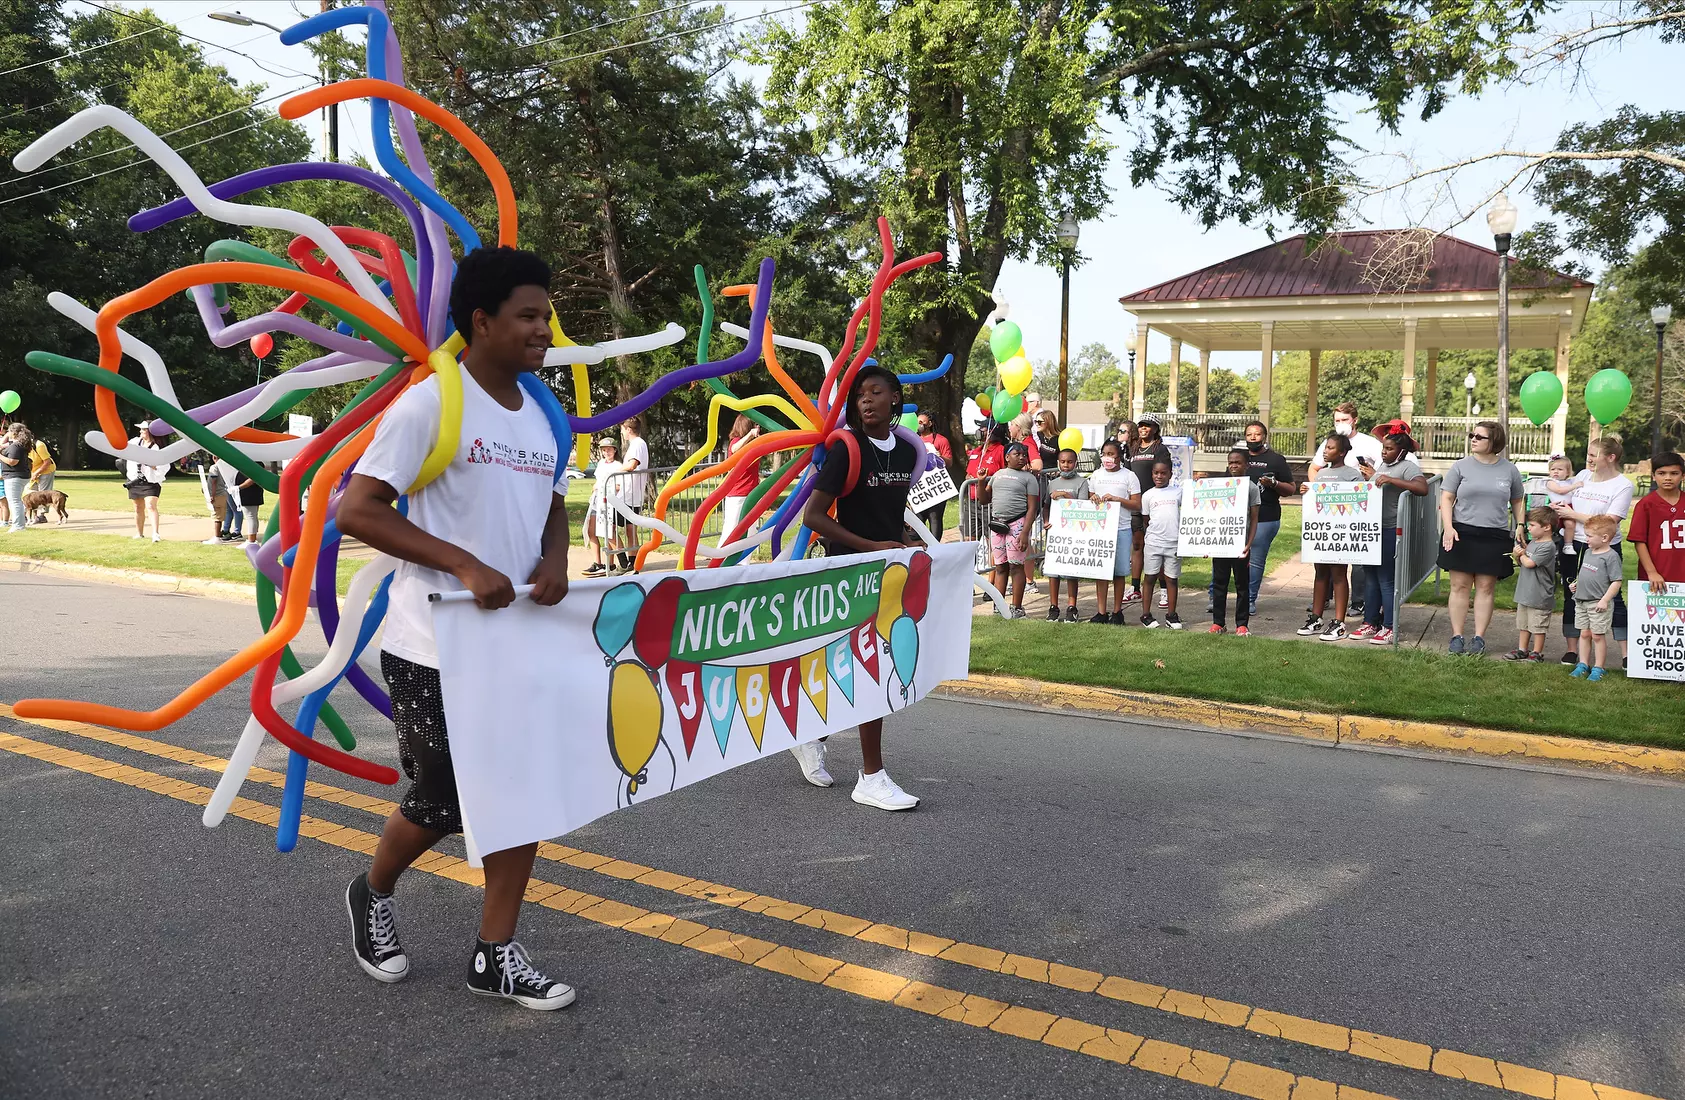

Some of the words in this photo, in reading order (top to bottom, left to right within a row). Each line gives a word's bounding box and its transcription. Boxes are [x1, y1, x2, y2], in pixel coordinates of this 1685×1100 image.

[532, 451, 555, 464] KIDS
[925, 469, 948, 486] RISE
[911, 481, 952, 505] CENTER
[1341, 494, 1358, 502] KIDS
[1182, 516, 1205, 526] BOYS
[1219, 516, 1244, 526] GIRLS
[1304, 521, 1332, 531] BOYS
[1349, 522, 1380, 532] GIRLS
[1180, 527, 1202, 536] CLUB
[1204, 527, 1216, 535] OF
[1219, 526, 1245, 536] WEST
[1049, 535, 1073, 545] BOYS
[1088, 539, 1114, 549] GIRLS
[1188, 537, 1235, 546] ALABAMA
[1302, 532, 1329, 541] CLUB
[1331, 532, 1347, 542] OF
[1349, 532, 1381, 543] WEST
[1046, 545, 1069, 555] CLUB
[1072, 548, 1085, 556] OF
[1088, 548, 1115, 559] WEST
[1313, 542, 1369, 553] ALABAMA
[1055, 555, 1104, 568] ALABAMA
[1648, 597, 1679, 606] NICK'S
[678, 593, 785, 655] NICK'S
[793, 579, 850, 631] KIDS
[854, 571, 880, 598] AVE
[1641, 624, 1684, 636] UNIVE
[1636, 635, 1651, 646] of
[1656, 636, 1684, 648] ALA
[1643, 648, 1685, 660] CHILD
[679, 621, 876, 721] JUBILEE
[1645, 659, 1685, 672] PROG
